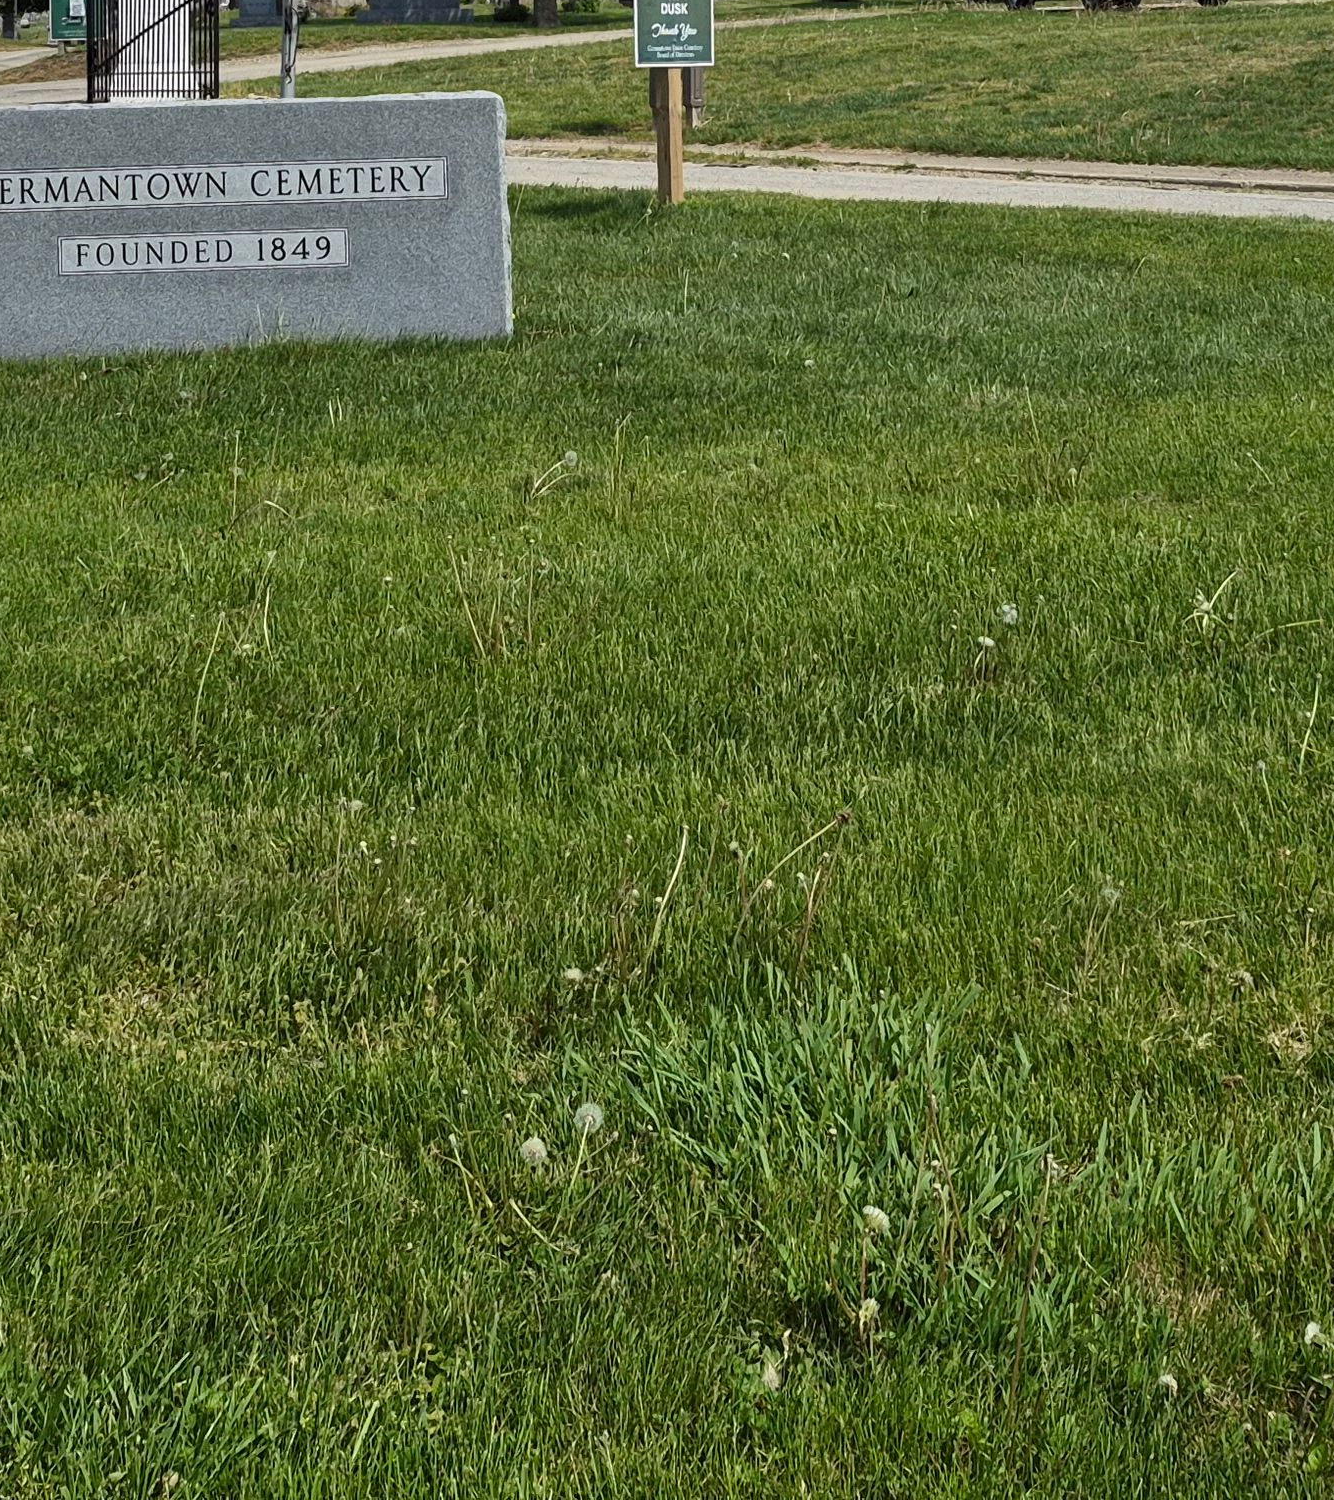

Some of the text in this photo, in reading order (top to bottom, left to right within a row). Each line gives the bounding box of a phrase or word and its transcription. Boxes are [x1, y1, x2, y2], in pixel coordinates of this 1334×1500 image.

[660, 2, 689, 15] DUSK
[250, 164, 433, 197] CEMETERY
[75, 236, 331, 267] FOUNDED 1849
